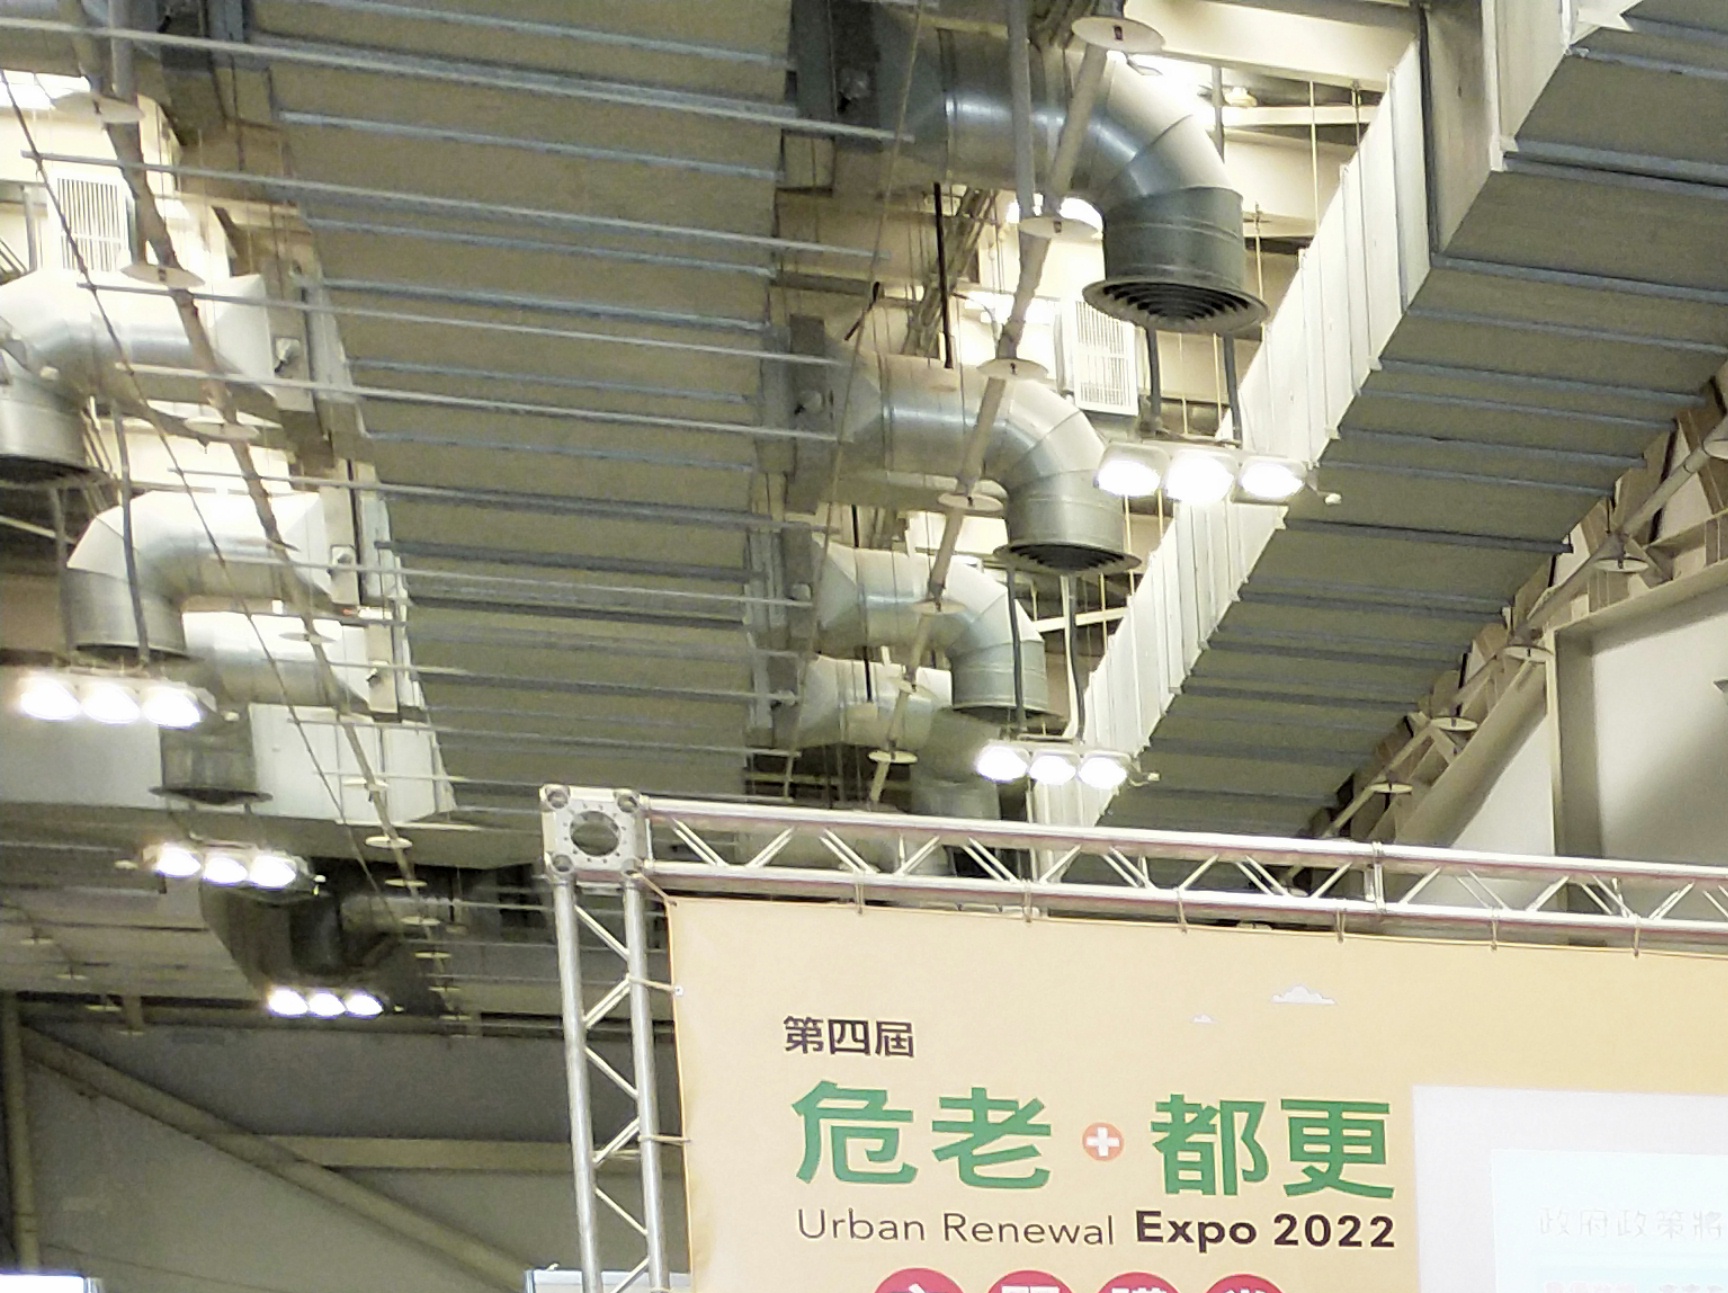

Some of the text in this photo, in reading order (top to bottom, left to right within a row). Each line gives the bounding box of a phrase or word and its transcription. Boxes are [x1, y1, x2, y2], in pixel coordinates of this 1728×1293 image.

[783, 1015, 915, 1058] 第四屆
[791, 1079, 1395, 1199] 危老 都更
[797, 1207, 1396, 1254] Urban Renewal Expo 2022
